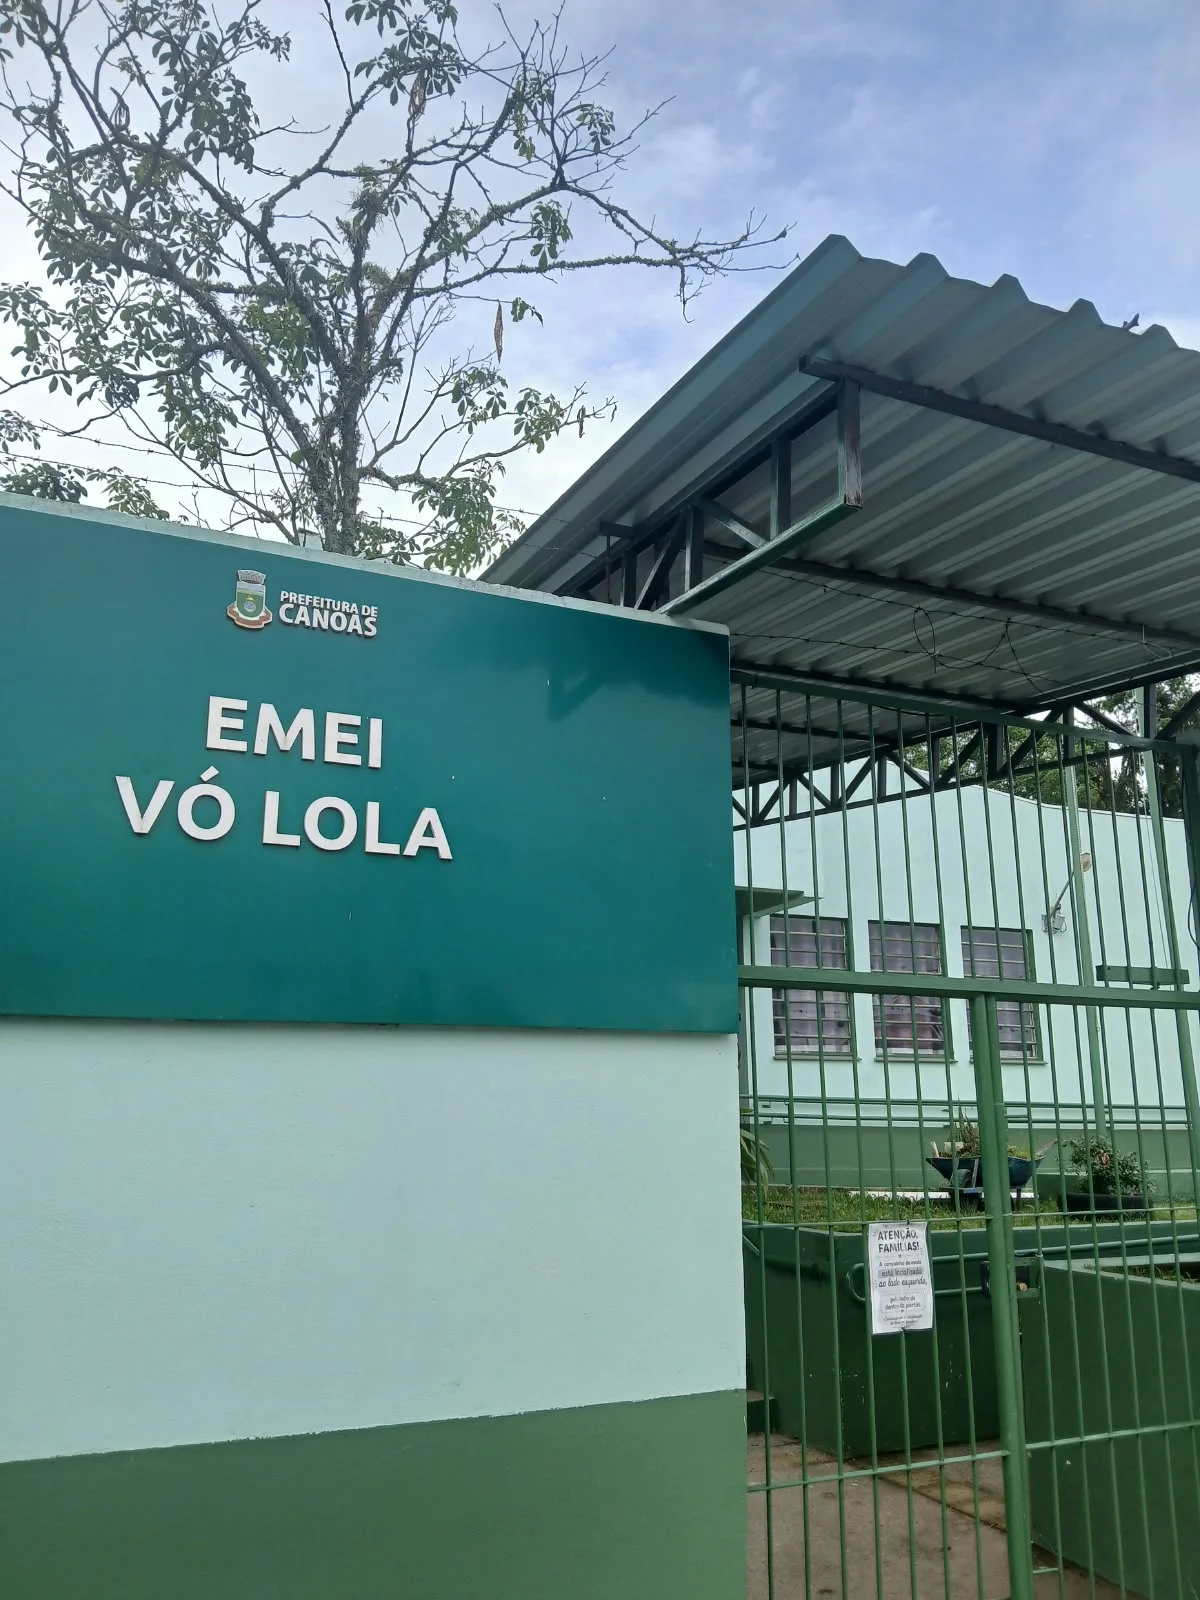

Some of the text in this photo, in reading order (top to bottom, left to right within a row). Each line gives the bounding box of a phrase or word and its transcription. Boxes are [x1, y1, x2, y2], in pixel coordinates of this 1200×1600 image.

[280, 590, 379, 618] PREFEITURA DE
[278, 603, 378, 637] CANOAS
[206, 695, 383, 769] EMEI
[115, 765, 453, 860] VÓ LOLA
[878, 1227, 919, 1241] ATENÇÃO,
[878, 1240, 920, 1253] FAMÍLIAS!
